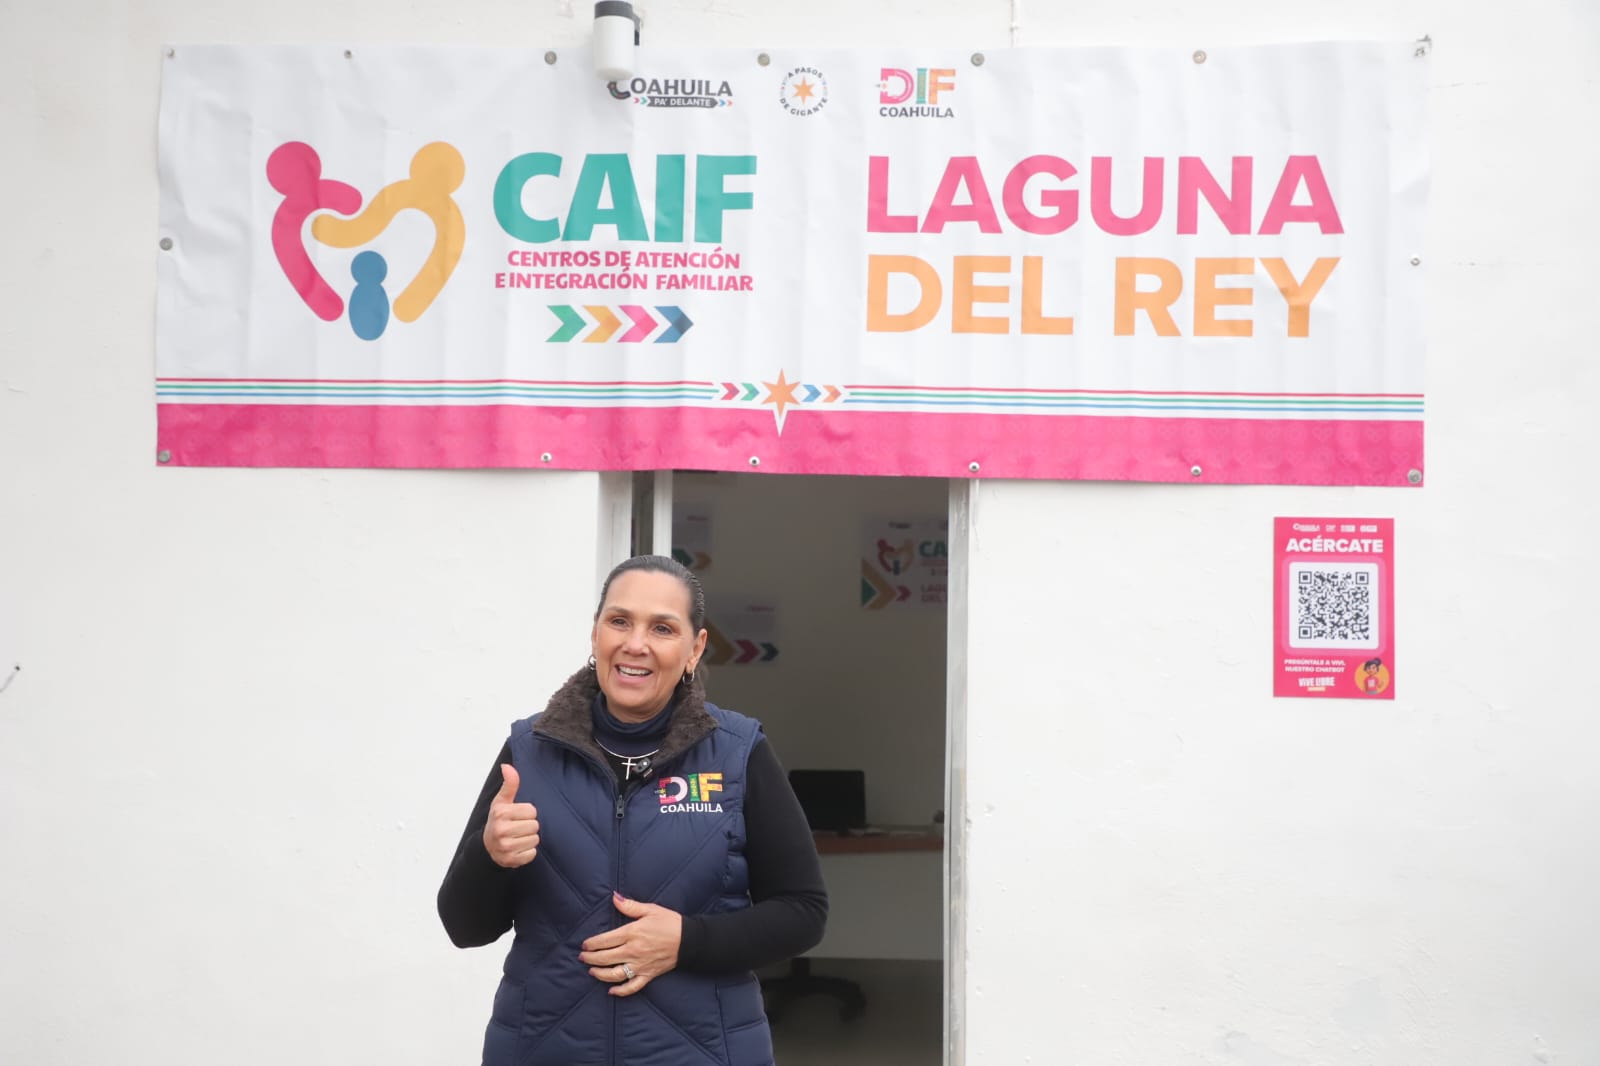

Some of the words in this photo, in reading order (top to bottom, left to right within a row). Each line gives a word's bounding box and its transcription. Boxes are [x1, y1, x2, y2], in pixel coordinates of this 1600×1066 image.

[795, 66, 823, 78] PASOS
[879, 68, 956, 104] DIF
[670, 98, 711, 106] DELANTE
[780, 97, 790, 110] DE
[790, 97, 828, 116] GIGANTE
[879, 107, 954, 117] COAHUILA
[493, 152, 757, 243] CAIF
[867, 154, 1345, 236] LAGUNA
[507, 250, 600, 267] CENTROS
[604, 251, 631, 267] DE
[635, 247, 740, 269] ATENCIÓN
[495, 273, 505, 288] E
[509, 267, 648, 289] INTEGRACIÓN
[656, 274, 753, 291] FAMILIAR
[866, 254, 1074, 335] DEL
[1113, 257, 1341, 338] REY
[1285, 535, 1384, 553] ACÉRCATE
[658, 772, 723, 804] DIF
[660, 803, 723, 814] COAHUILA
